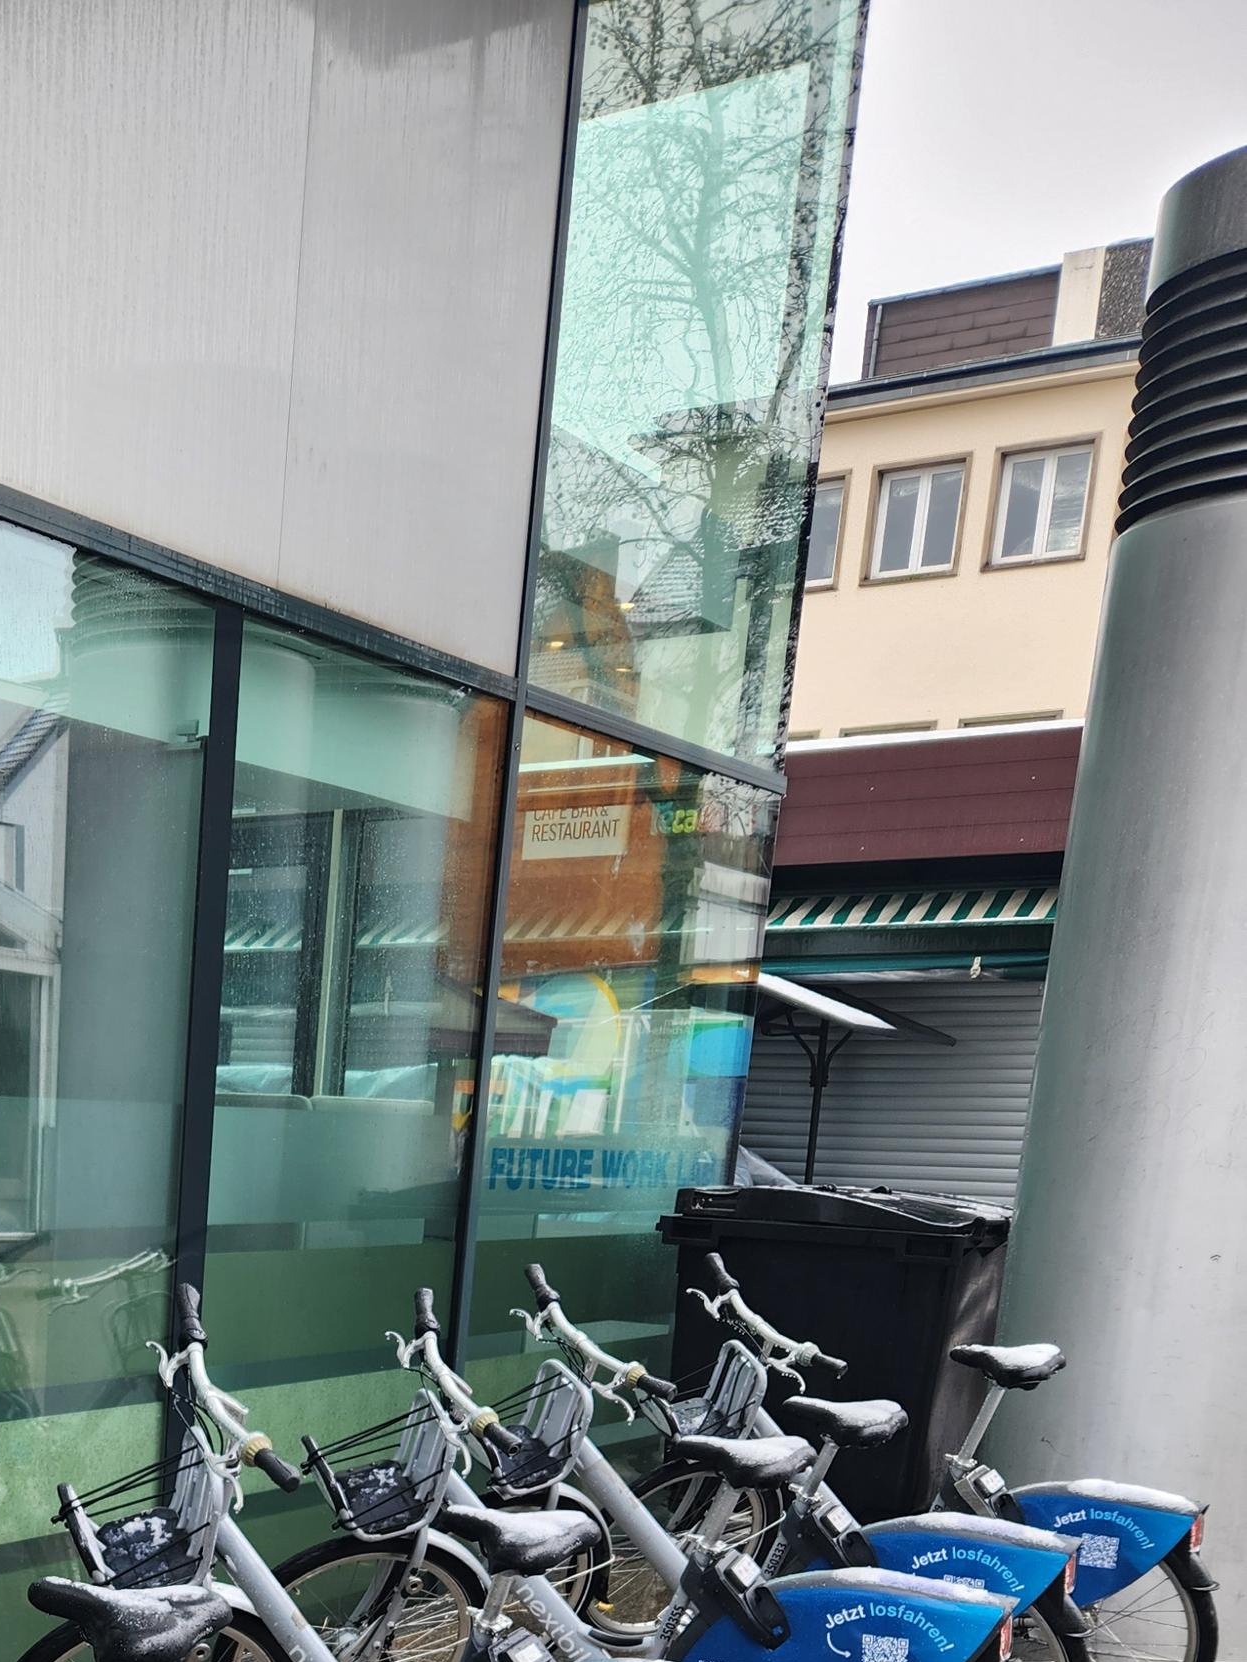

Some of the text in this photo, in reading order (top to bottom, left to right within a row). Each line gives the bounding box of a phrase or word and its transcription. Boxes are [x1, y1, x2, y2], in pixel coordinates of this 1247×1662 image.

[532, 819, 620, 842] RESTAURANT
[489, 1147, 594, 1191] FUTURE
[602, 1149, 669, 1189] WORK
[1054, 1508, 1155, 1550] Jetzt losfahren!
[764, 1542, 787, 1576] 350333
[911, 1546, 1026, 1593] Jetzt losfahren!
[660, 1605, 684, 1642] 350355
[825, 1602, 955, 1652] Jetzt losfahren!
